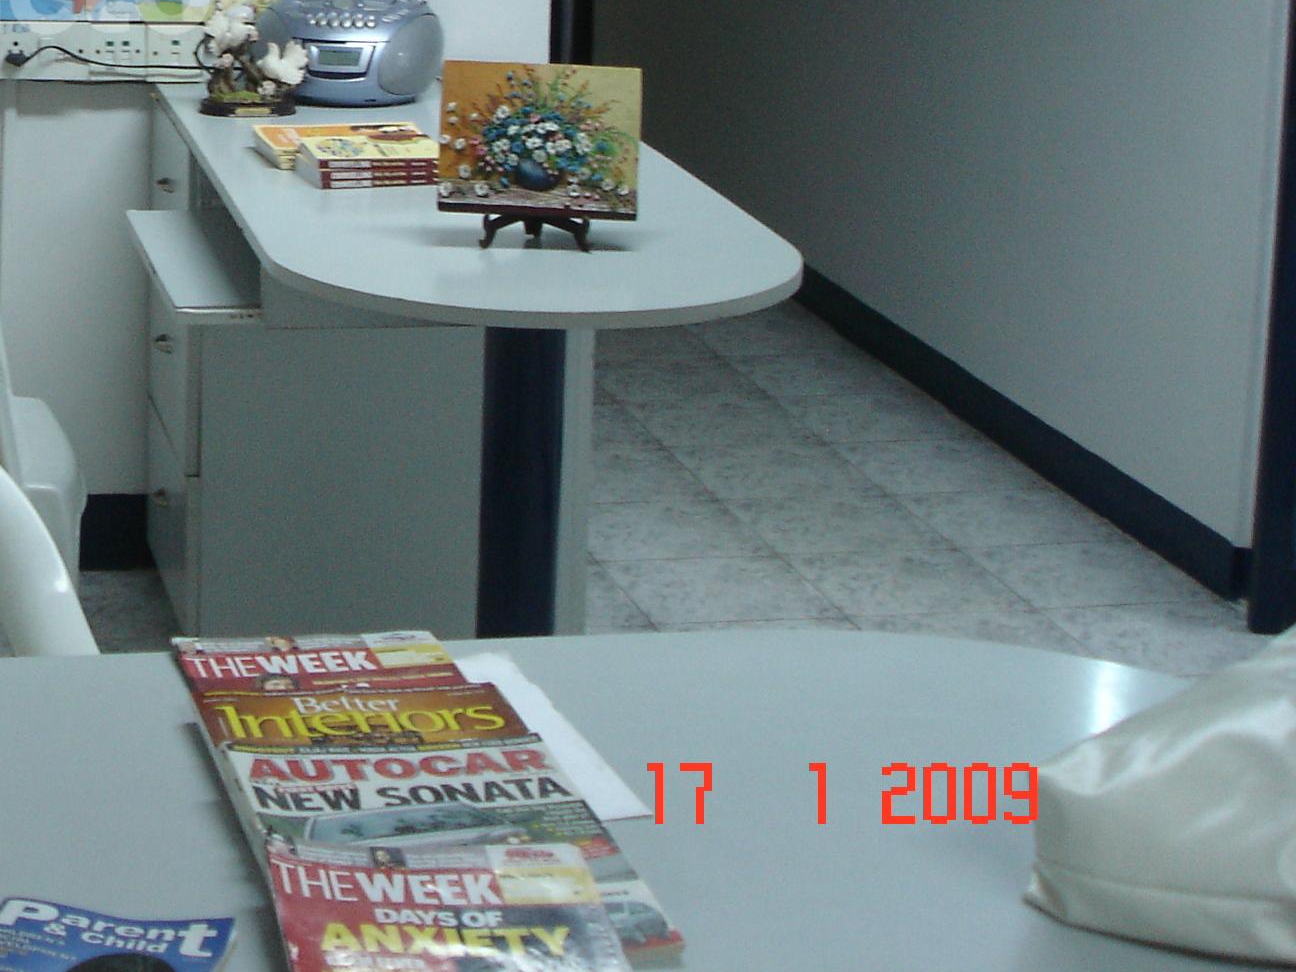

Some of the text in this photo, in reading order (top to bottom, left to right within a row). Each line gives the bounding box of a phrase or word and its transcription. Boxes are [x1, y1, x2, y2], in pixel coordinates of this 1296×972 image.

[215, 703, 505, 740] Interiors
[292, 696, 400, 715] Better
[249, 748, 547, 783] AUTOCAR
[253, 776, 574, 812] NEW SONATA
[374, 908, 503, 928] DAYS OF
[43, 921, 67, 937] &
[81, 930, 169, 954] Child
[321, 923, 570, 958] ANXIETY
